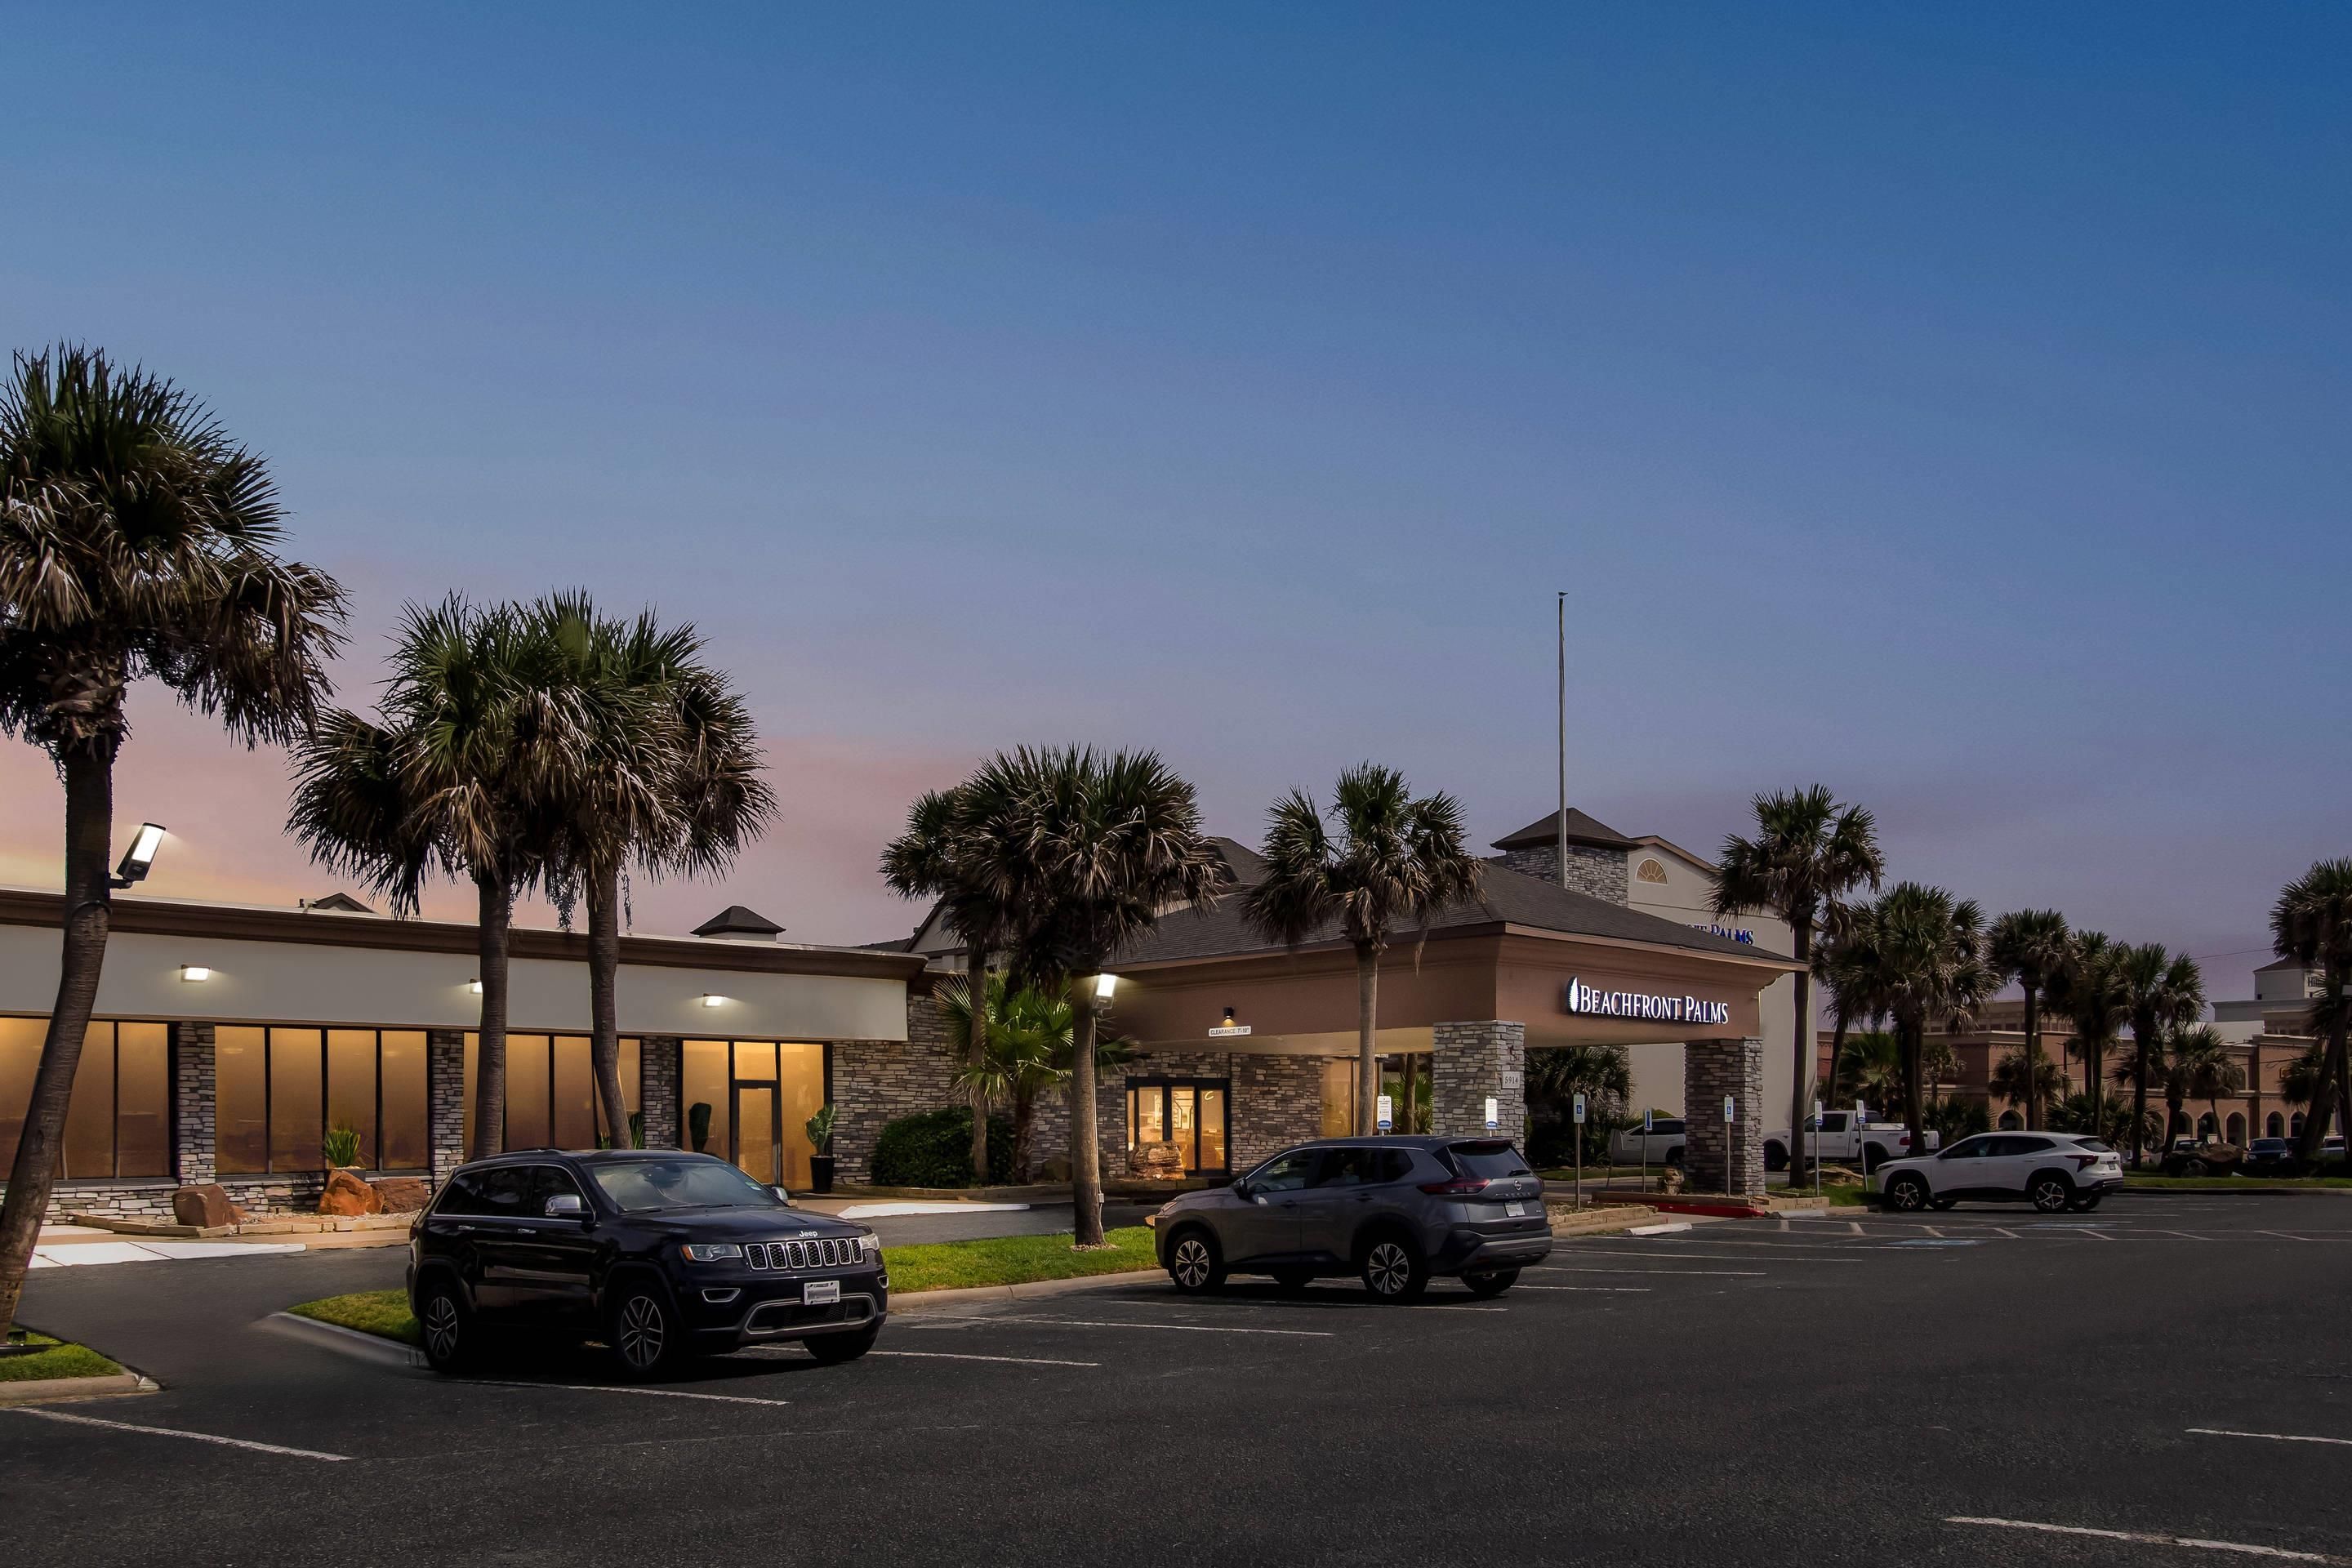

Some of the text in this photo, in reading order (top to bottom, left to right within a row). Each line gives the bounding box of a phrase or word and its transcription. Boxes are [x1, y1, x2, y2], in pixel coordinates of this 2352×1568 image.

[1579, 985, 1729, 1024] BEACHFRONT PALMS
[1504, 1076, 1518, 1085] 5914
[799, 1230, 817, 1238] Jeep
